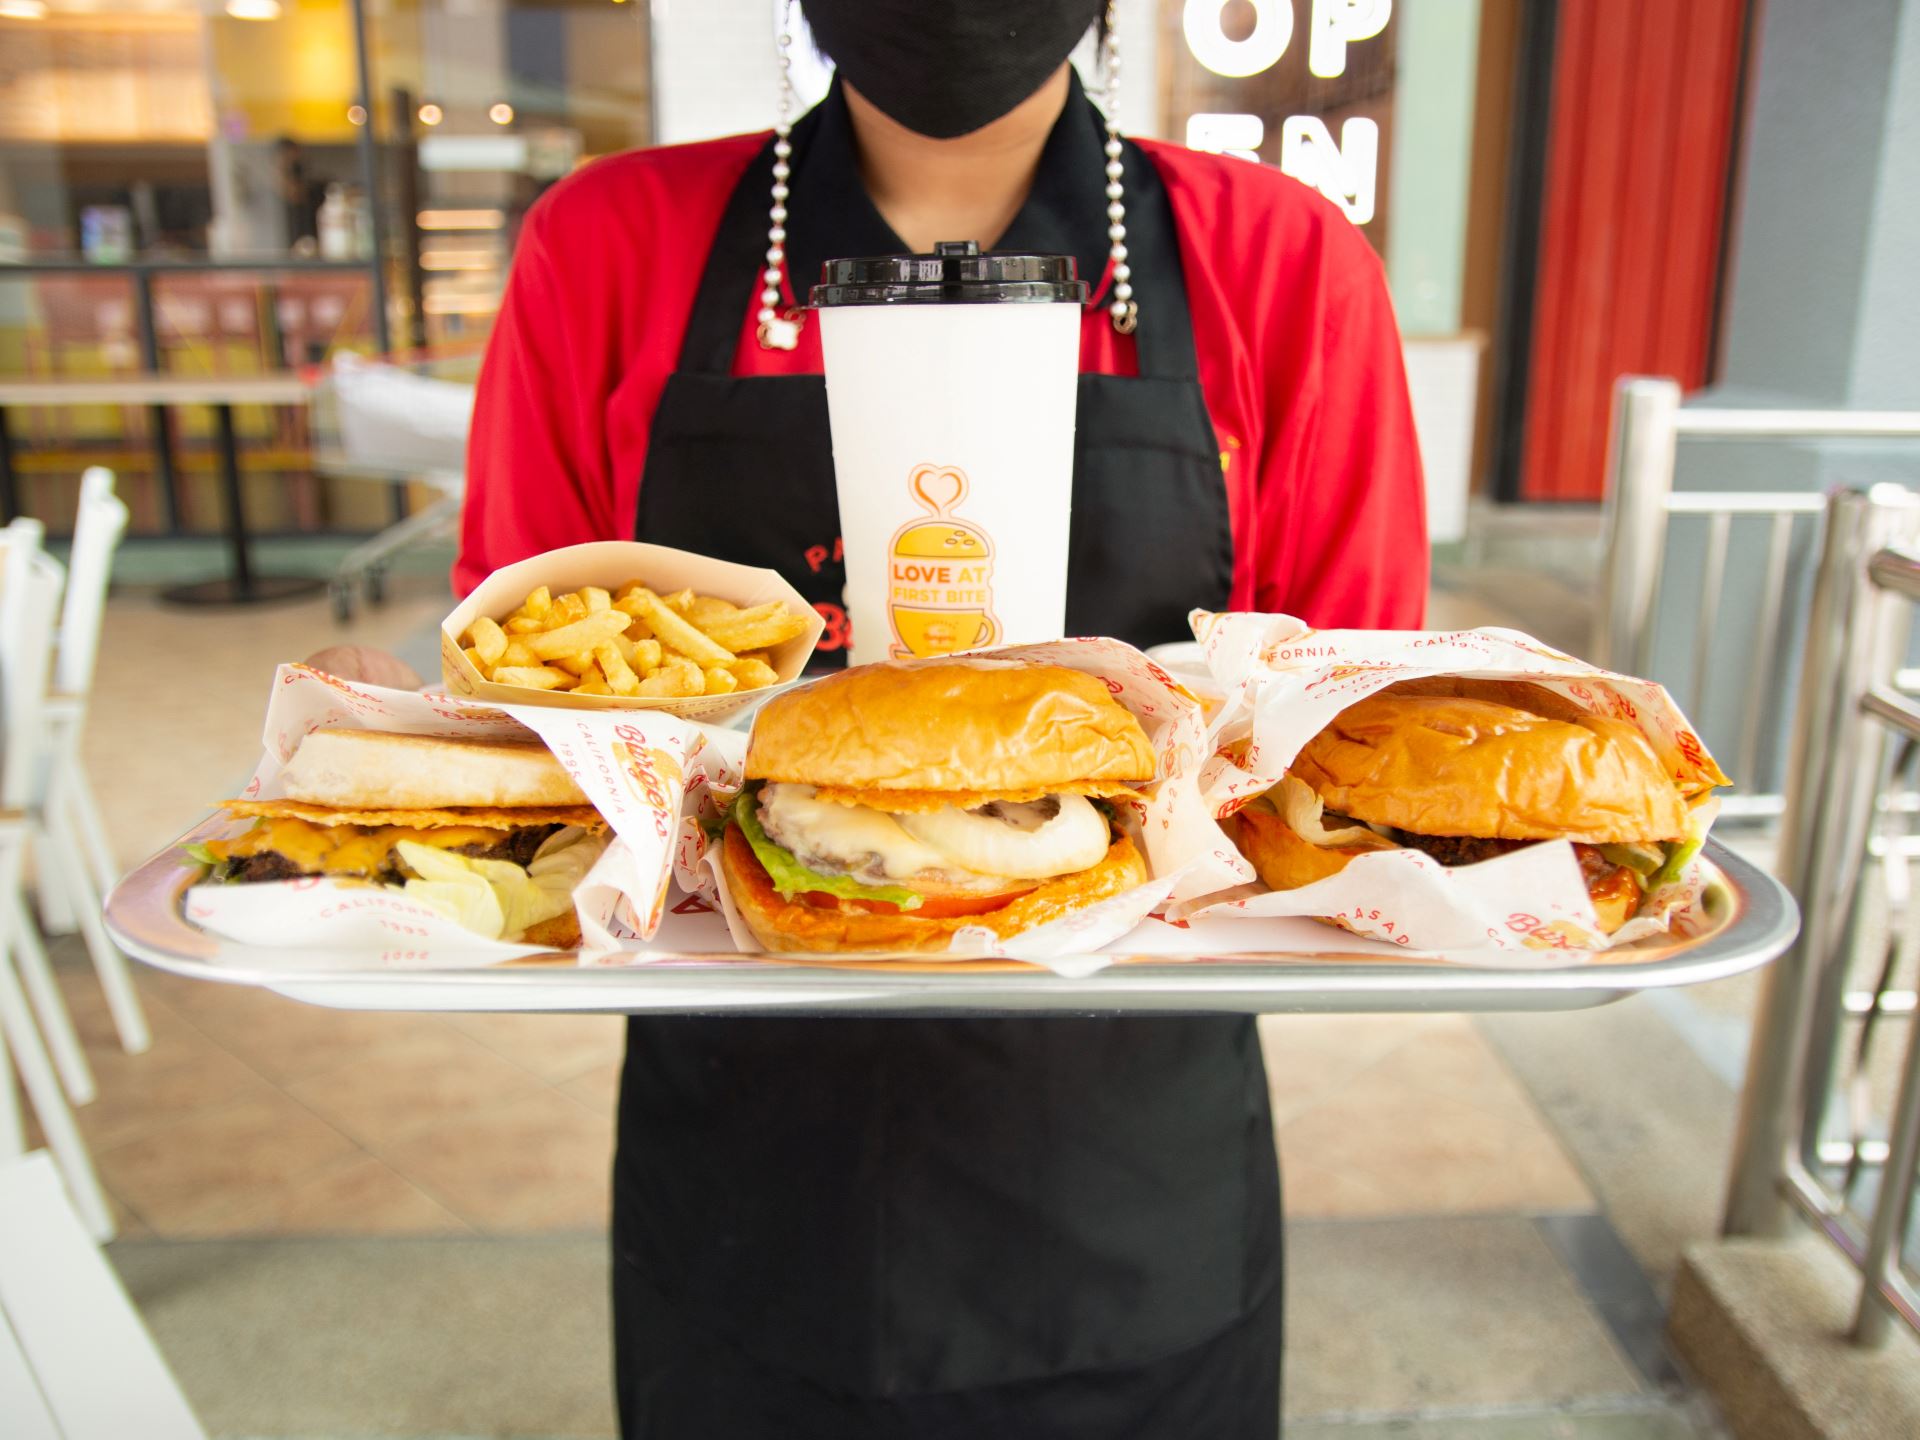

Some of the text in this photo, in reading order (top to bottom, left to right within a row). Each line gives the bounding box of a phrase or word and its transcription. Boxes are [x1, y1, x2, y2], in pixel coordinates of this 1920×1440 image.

[1183, 0, 1392, 78] OP
[893, 563, 986, 583] LOVE AT
[893, 587, 985, 603] FIRST BITE
[577, 721, 625, 814] CALIFORNIA
[614, 724, 669, 838] Burgers
